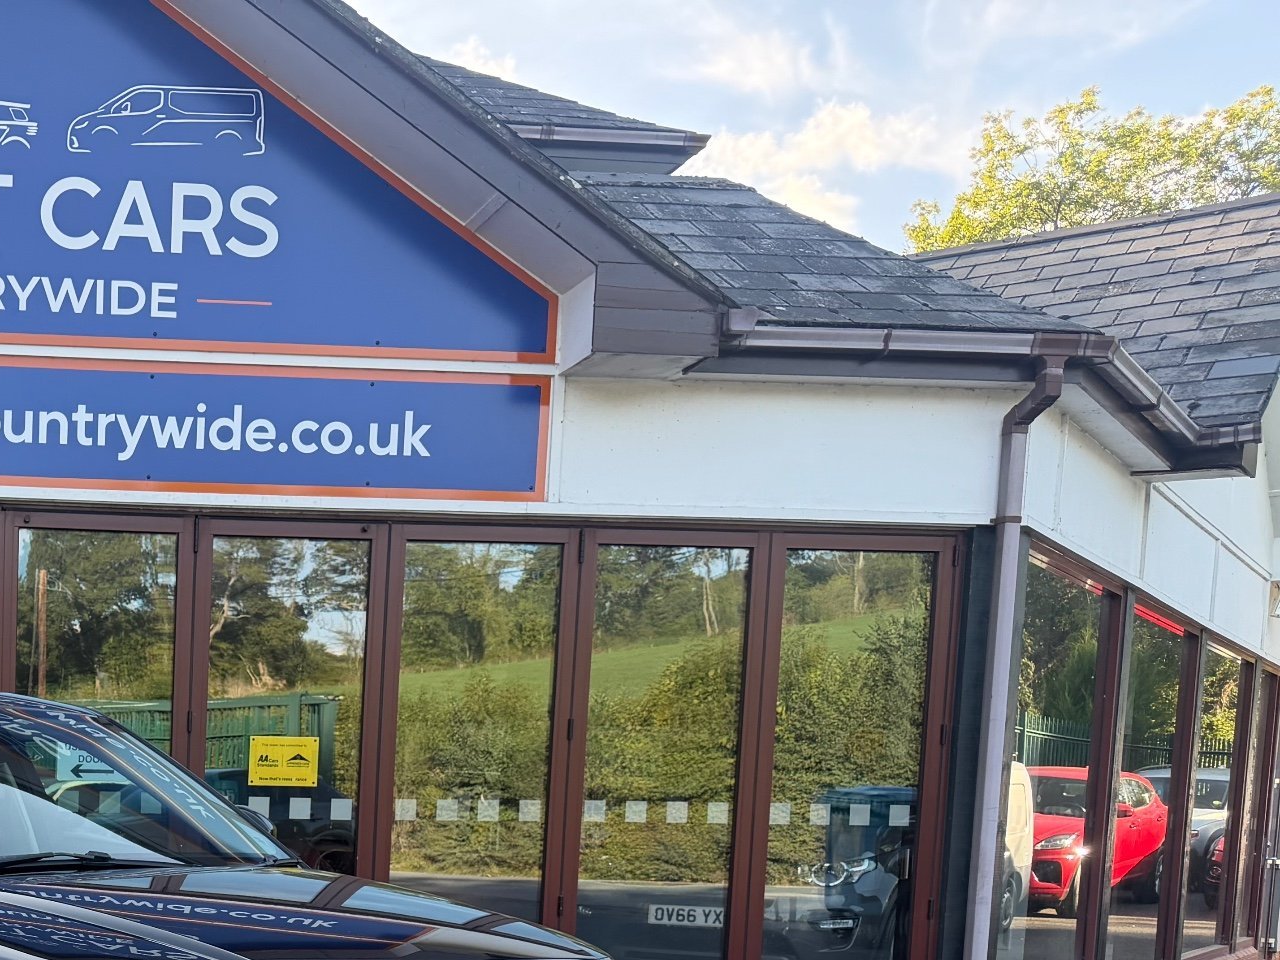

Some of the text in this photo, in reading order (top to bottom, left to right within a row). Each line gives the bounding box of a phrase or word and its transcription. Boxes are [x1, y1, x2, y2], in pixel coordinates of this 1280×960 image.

[40, 176, 280, 259] CARS
[78, 754, 103, 764] DOO
[654, 907, 697, 924] OV66
